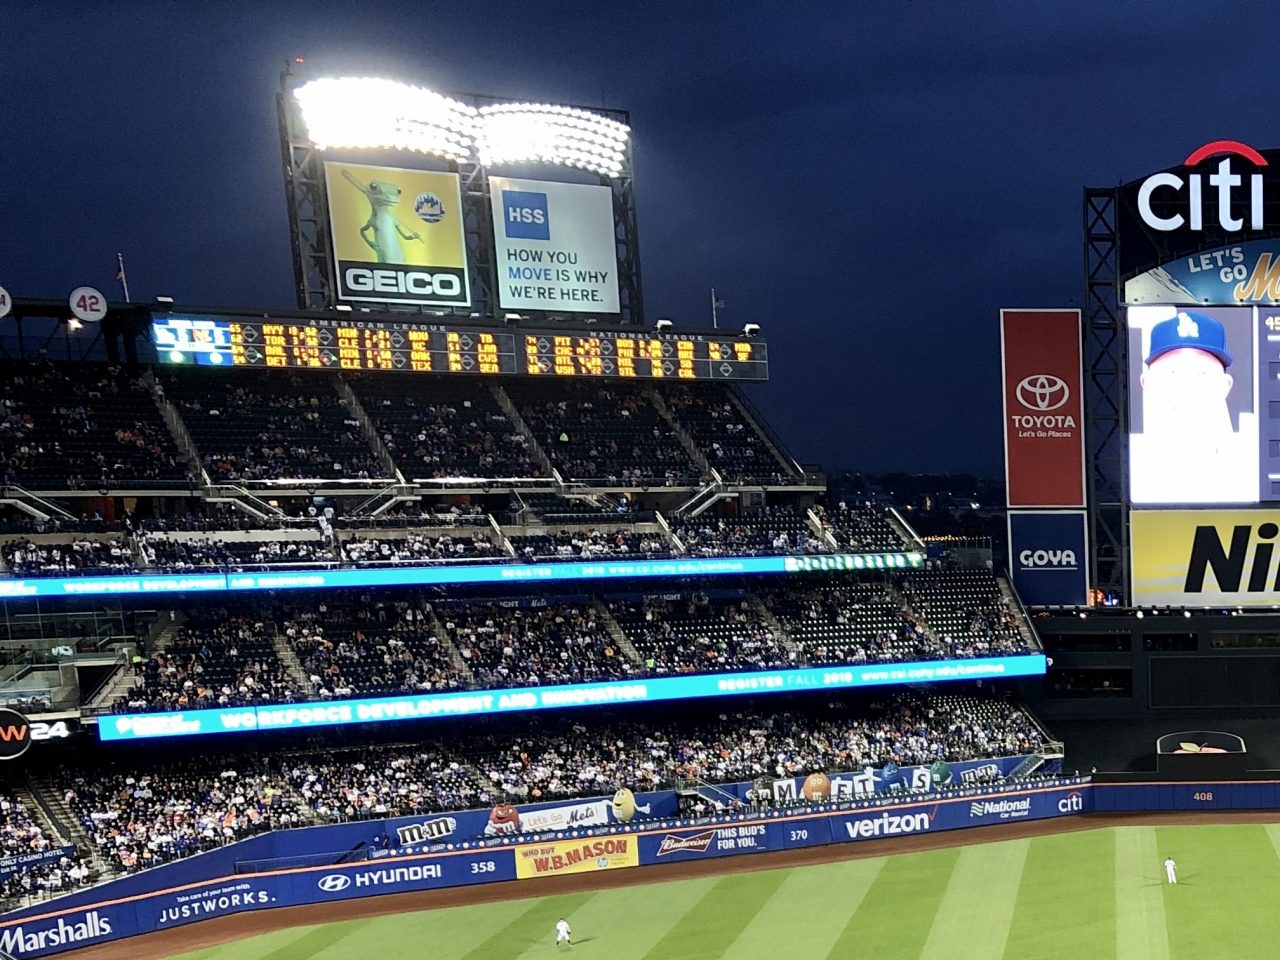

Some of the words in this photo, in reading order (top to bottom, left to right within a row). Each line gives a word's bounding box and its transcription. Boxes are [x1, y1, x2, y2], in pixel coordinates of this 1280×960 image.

[1137, 158, 1263, 232] citi
[509, 207, 544, 224] HSS
[507, 249, 544, 262] HOW
[546, 250, 578, 265] YOU
[1188, 247, 1244, 273] LET'S
[345, 268, 461, 296] GEICO
[508, 266, 552, 281] MOVE
[555, 269, 570, 281] IS
[575, 270, 608, 284] WHY
[1219, 264, 1248, 284] GO
[509, 285, 556, 300] WE'RE
[560, 288, 604, 302] HERE.
[76, 294, 101, 312] 42
[309, 319, 384, 329] AMERICAN
[393, 323, 447, 332] LEAGUE
[590, 331, 651, 340] NATIONAL
[1012, 415, 1076, 429] TOYOTA
[1018, 430, 1035, 438] Let's
[1036, 430, 1047, 438] Go
[1047, 430, 1072, 438] Places
[1019, 549, 1076, 567] GOYA
[717, 676, 785, 692] REGISTER
[29, 721, 69, 740] 24
[1057, 792, 1082, 813] citi
[1192, 791, 1213, 802] 408
[984, 797, 1031, 815] National
[1011, 809, 1029, 817] Rental
[527, 816, 548, 826] Let's
[550, 812, 563, 821] Go
[846, 811, 930, 838] verizon
[661, 832, 712, 851] Budweiser
[716, 828, 739, 840] THIS
[740, 825, 765, 838] BUD'S
[790, 829, 808, 841] 370
[521, 848, 539, 857] WHO
[540, 847, 555, 855] BUT
[717, 840, 736, 850] FOR
[737, 837, 757, 848] YOU.
[0, 856, 18, 867] ONLY
[18, 852, 43, 863] CASINO
[44, 848, 65, 859] HOTEL
[533, 839, 628, 873] W.B.MASON
[355, 864, 441, 887] HYUNDAI
[470, 861, 495, 874] 358
[209, 889, 221, 897] your
[159, 890, 276, 923] JUSTWORKS.
[0, 911, 111, 954] Marshalls
